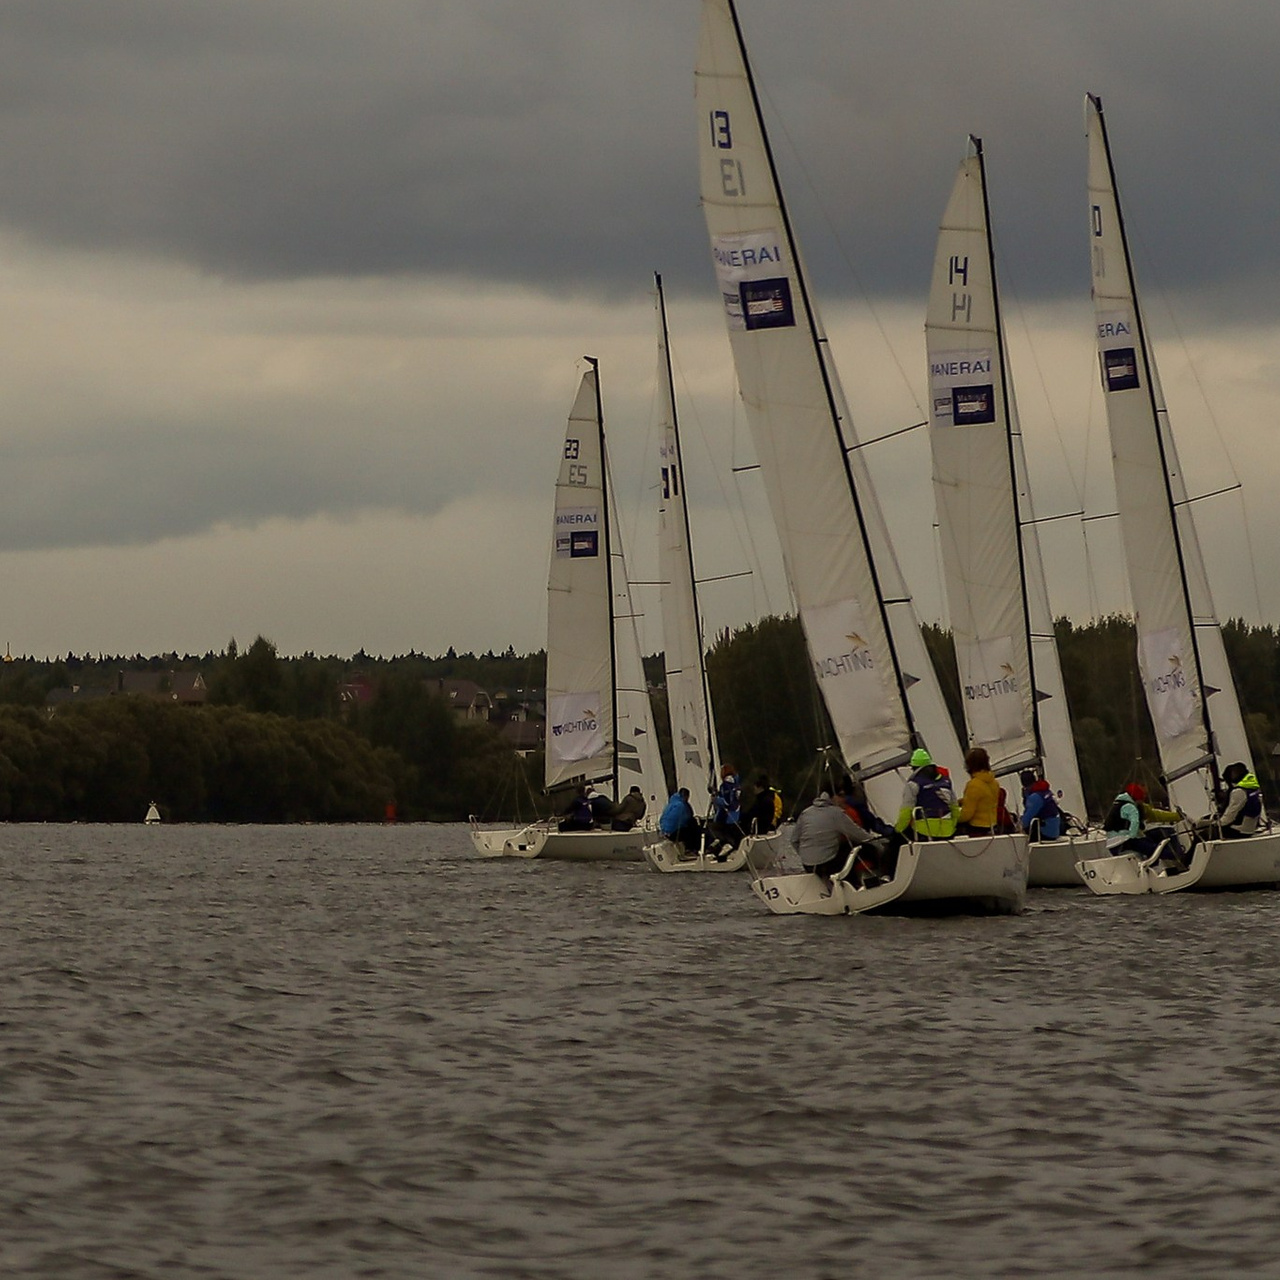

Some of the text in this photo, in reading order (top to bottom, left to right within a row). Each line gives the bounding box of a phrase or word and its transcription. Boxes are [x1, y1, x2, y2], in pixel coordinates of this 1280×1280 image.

[709, 109, 733, 150] 13
[949, 256, 969, 287] 14
[564, 438, 580, 460] 23
[1084, 869, 1097, 880] 10
[764, 887, 780, 901] 13
